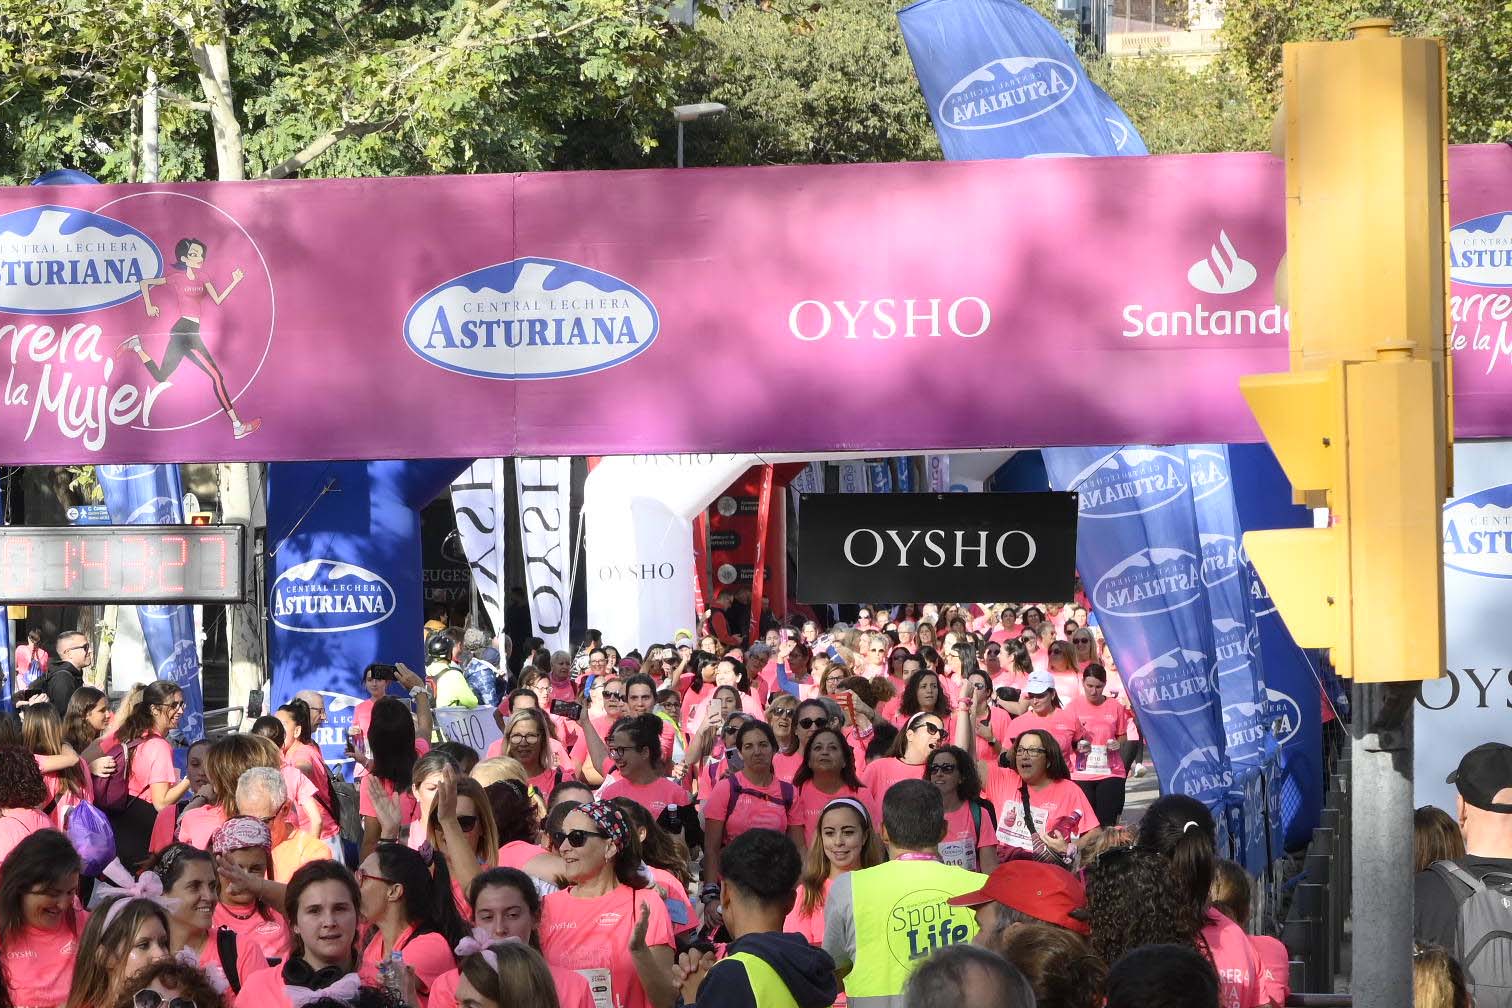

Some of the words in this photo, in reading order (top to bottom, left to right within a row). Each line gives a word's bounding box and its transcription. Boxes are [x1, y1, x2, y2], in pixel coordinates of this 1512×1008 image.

[550, 298, 631, 311] LECHERA
[788, 297, 991, 341] OYSHO
[424, 305, 639, 349] ASTURIANA
[4, 367, 28, 405] la
[24, 358, 173, 451] Mujer
[843, 528, 1037, 569] OYSHO
[599, 562, 675, 583] OYSHO
[274, 589, 387, 616] ASTURIANA
[892, 897, 956, 932] Sport
[906, 918, 969, 960] Life
